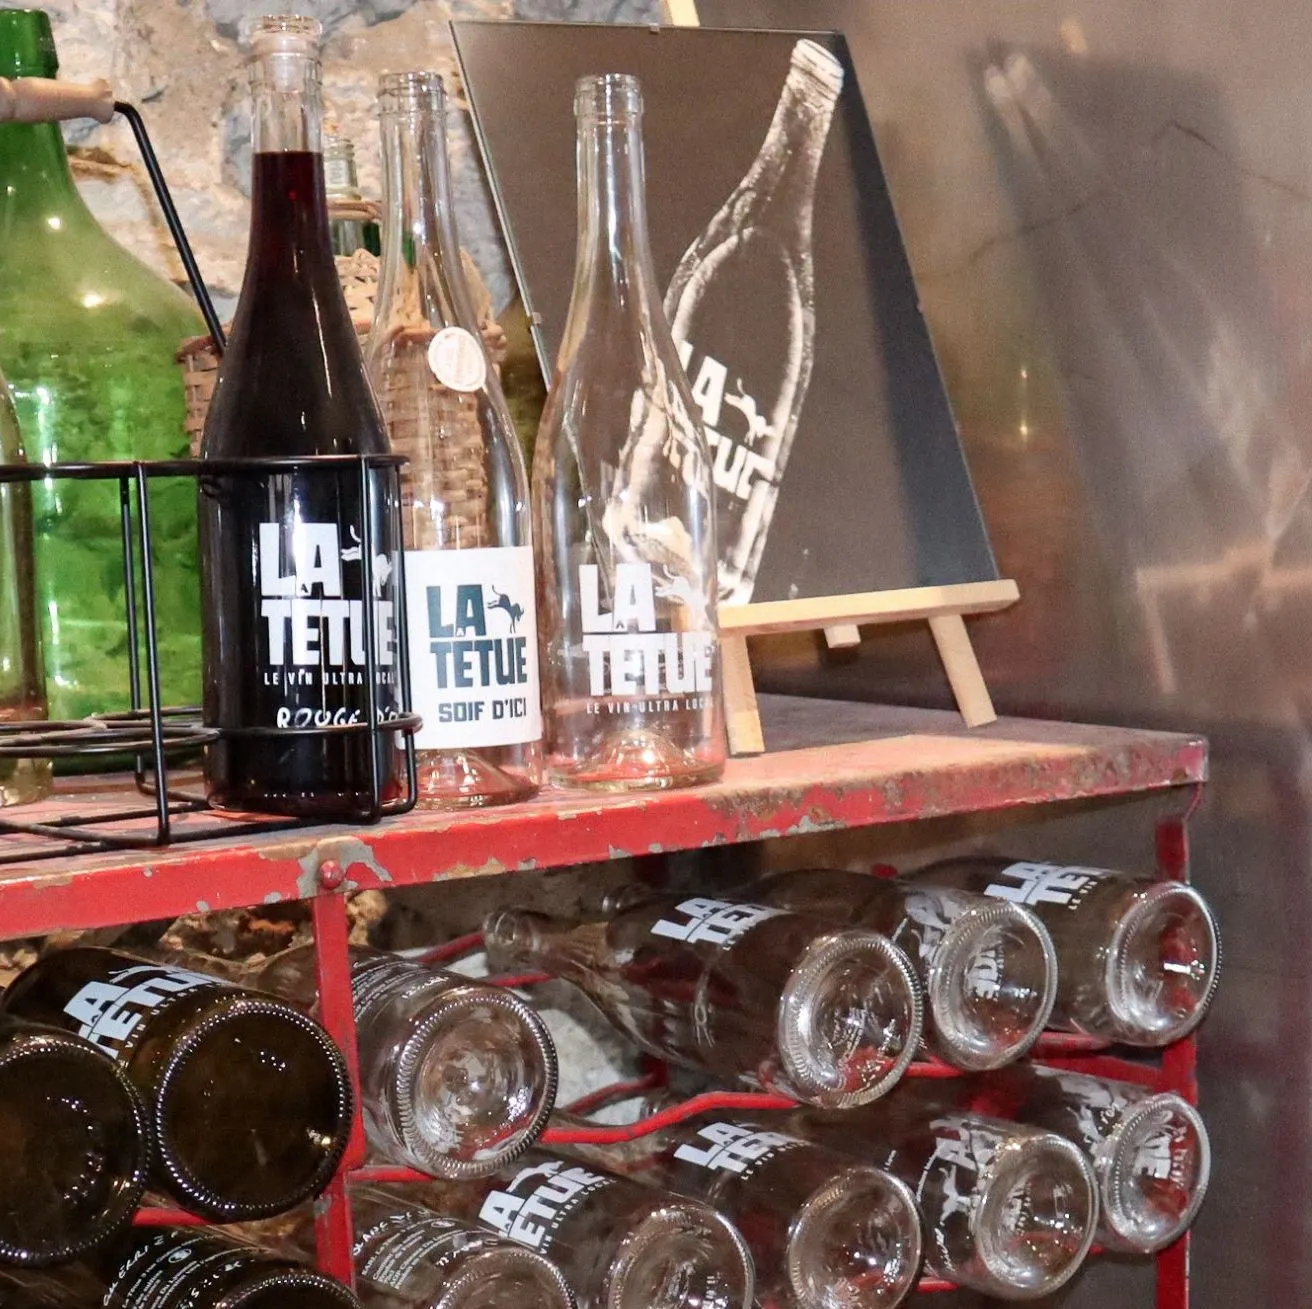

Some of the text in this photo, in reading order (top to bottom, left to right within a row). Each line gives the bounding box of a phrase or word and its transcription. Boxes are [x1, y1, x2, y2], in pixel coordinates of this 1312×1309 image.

[259, 523, 341, 596] LA
[426, 584, 486, 638] LA
[579, 563, 656, 632] LA
[264, 671, 395, 685] LE VIN ULTRA OCAL
[430, 637, 527, 688] TETUE
[582, 631, 712, 696] TETUE
[438, 697, 527, 722] SOIF D'ICI
[587, 702, 599, 714] LE
[608, 702, 630, 714] VIN
[639, 699, 678, 713] ULTRA
[984, 862, 1061, 902] LA
[650, 897, 733, 941] LA
[673, 1122, 754, 1167] LA
[479, 1190, 526, 1238] A
[508, 1167, 606, 1247] ETUE
